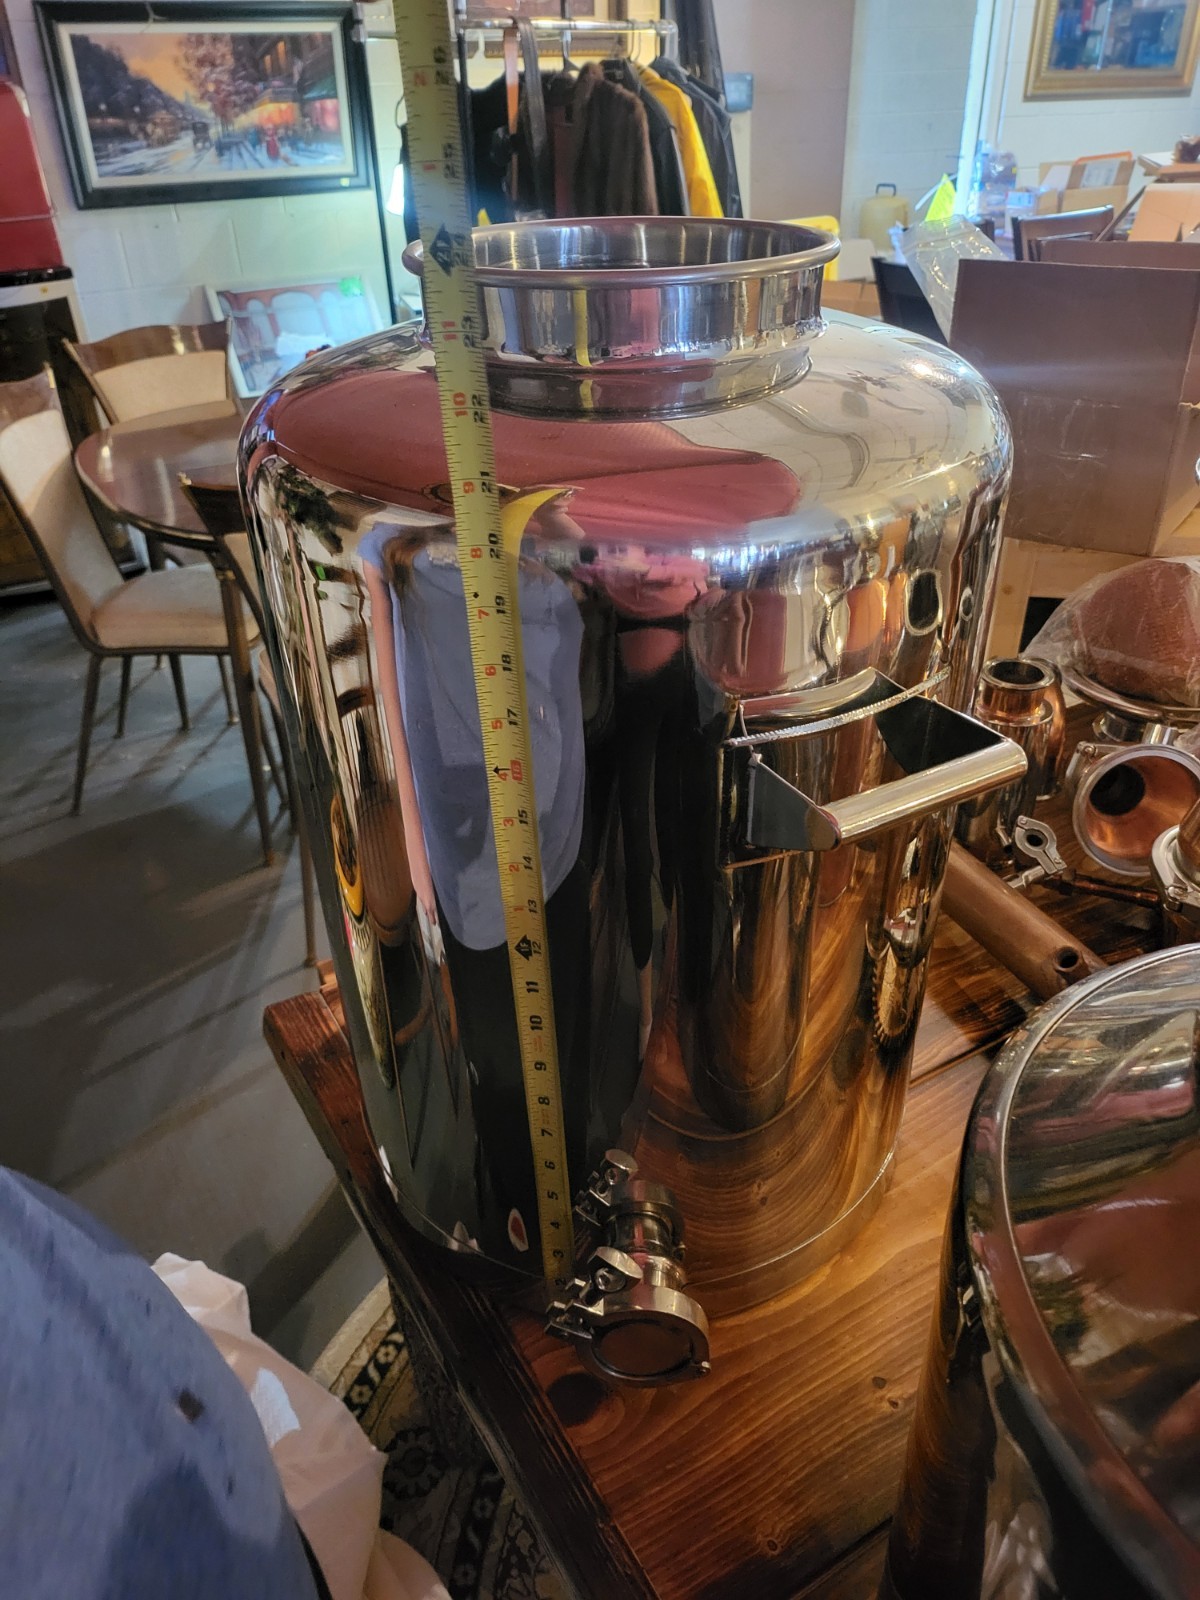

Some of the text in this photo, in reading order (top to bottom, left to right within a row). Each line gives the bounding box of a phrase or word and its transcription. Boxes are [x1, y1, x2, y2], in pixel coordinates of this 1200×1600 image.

[442, 320, 458, 341] 11
[461, 315, 475, 348] 23
[452, 392, 468, 417] 10
[472, 394, 486, 423] 22
[463, 481, 474, 494] 9
[480, 471, 492, 493] 21
[488, 533, 500, 559] 20
[470, 547, 483, 559] 8
[495, 595, 506, 614] 19
[477, 608, 490, 620] 7
[501, 654, 513, 672] 18
[485, 665, 497, 676] 6
[507, 708, 519, 726] 17
[491, 719, 503, 730] 5
[498, 771, 509, 781] 4
[503, 818, 514, 827] 3
[518, 809, 529, 825] 15
[508, 863, 520, 873] 2
[522, 855, 533, 871] 14
[528, 899, 539, 914] 13
[532, 941, 542, 955] 12
[526, 981, 539, 993] 11
[529, 1015, 543, 1031] 10
[534, 1061, 547, 1071] 9
[538, 1096, 550, 1106] 8
[541, 1128, 553, 1137] 7
[544, 1160, 556, 1170] 6
[547, 1191, 559, 1200] 5
[550, 1221, 561, 1230] 4
[553, 1250, 564, 1259] 3
[555, 1277, 566, 1286] 2
